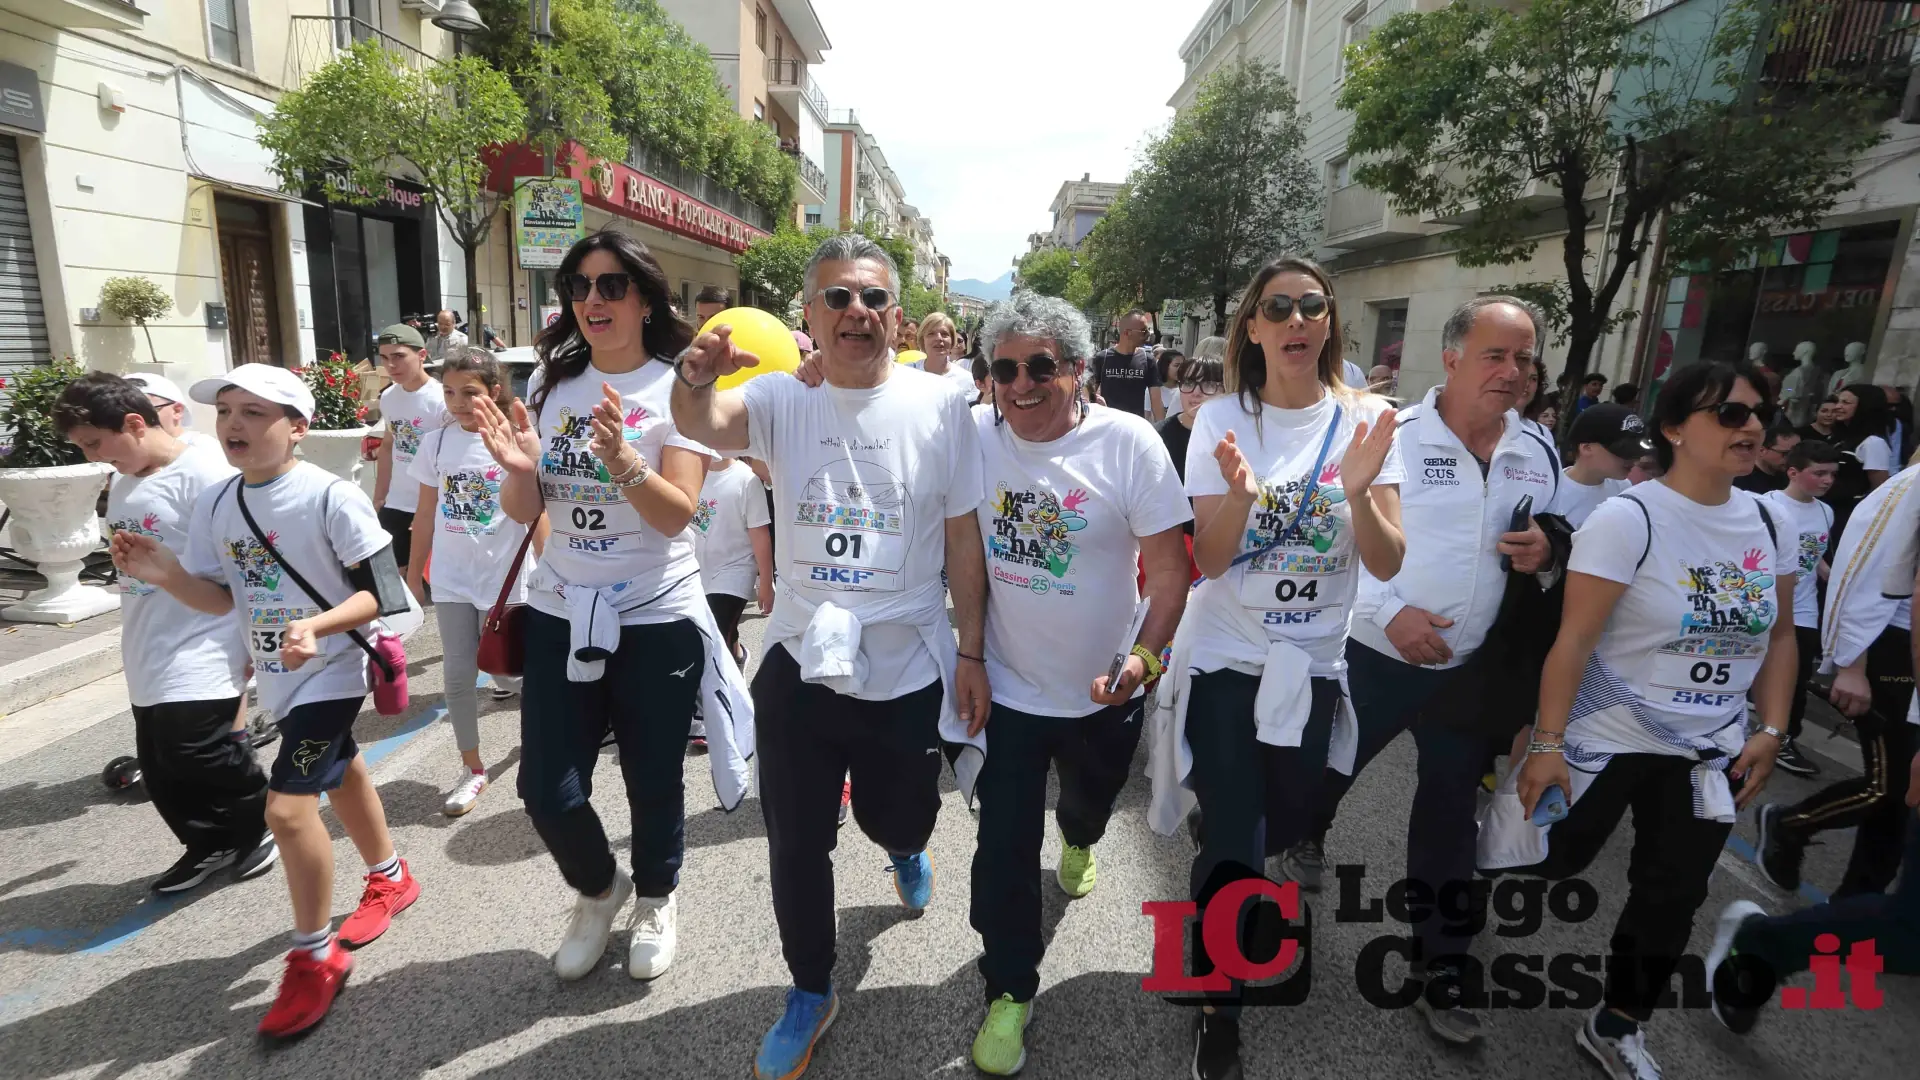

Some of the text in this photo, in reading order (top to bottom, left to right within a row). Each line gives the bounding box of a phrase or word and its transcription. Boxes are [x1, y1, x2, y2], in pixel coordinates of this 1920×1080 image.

[628, 175, 673, 216] BANCA
[677, 198, 727, 236] POPOLARE
[730, 220, 744, 242] DEL
[1105, 368, 1144, 376] HILFIGER
[1423, 458, 1457, 467] GEMS
[1425, 468, 1455, 478] CUS
[1422, 478, 1460, 486] CASSINO
[571, 507, 606, 530] 02
[568, 537, 619, 551] SKF
[825, 532, 862, 559] 01
[811, 566, 874, 584] SKF
[994, 566, 1029, 584] Cassino
[1031, 578, 1048, 591] 25
[1051, 580, 1076, 591] Aprile
[1275, 579, 1318, 602] 04
[1263, 609, 1321, 624] SKF
[1690, 662, 1731, 685] 05
[1672, 691, 1734, 706] SKF
